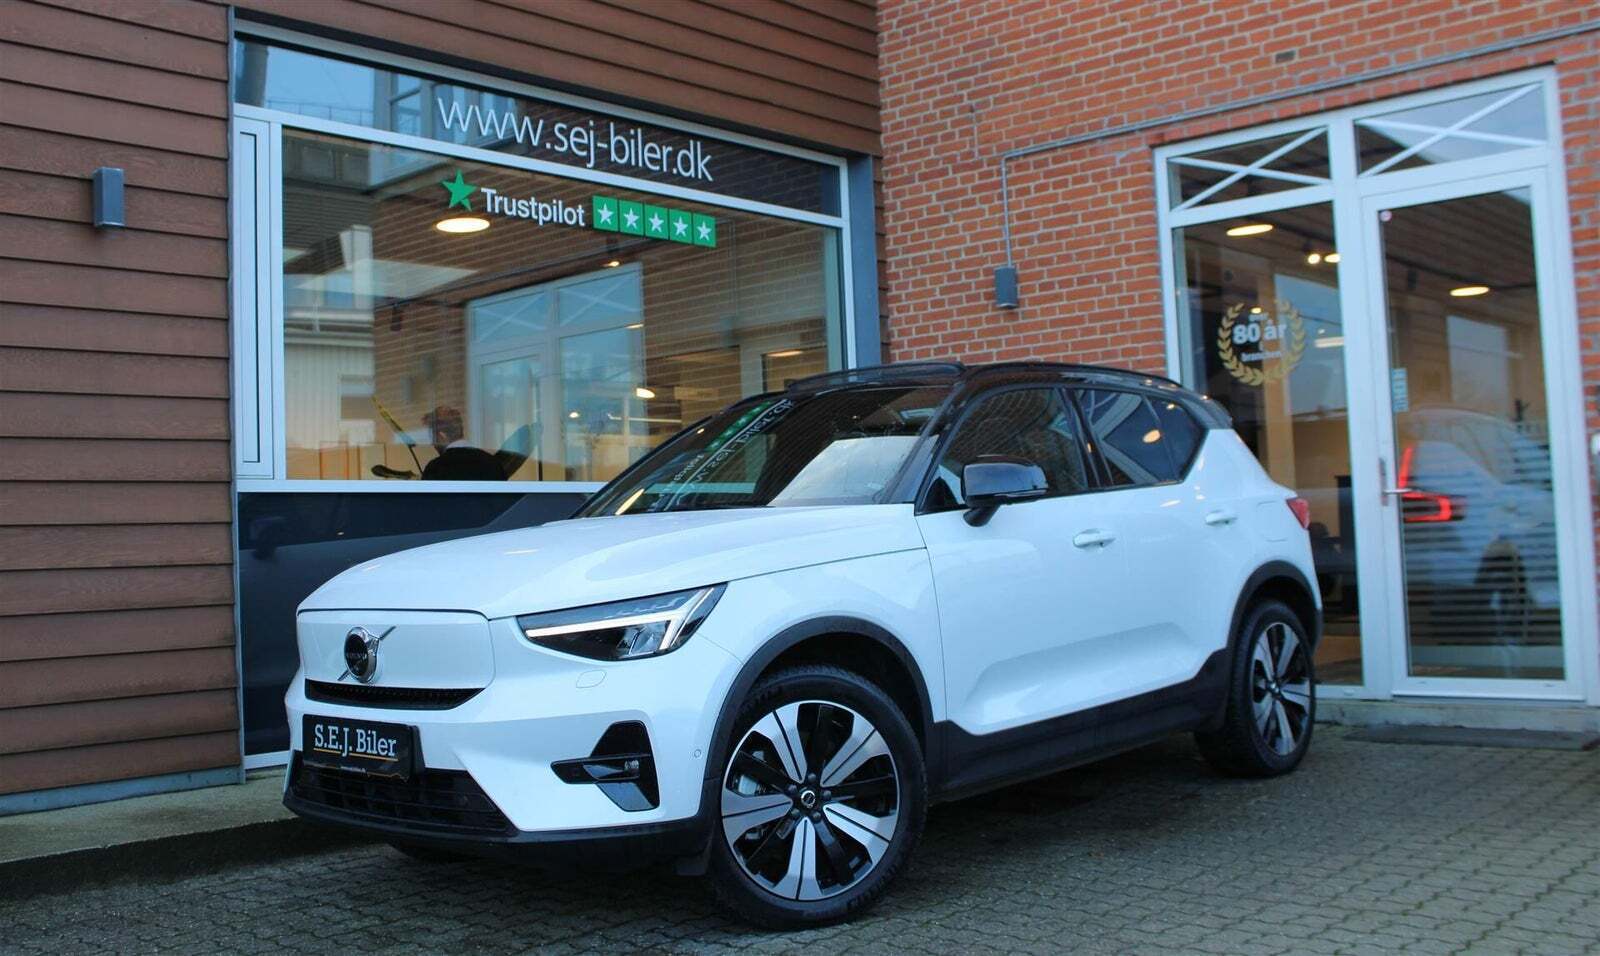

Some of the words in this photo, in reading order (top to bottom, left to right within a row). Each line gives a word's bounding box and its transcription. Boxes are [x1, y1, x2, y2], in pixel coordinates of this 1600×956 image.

[437, 97, 713, 182] www.sej-biler.dk
[481, 187, 586, 227] Trustpilot
[1233, 323, 1261, 344] 80
[1264, 319, 1288, 340] år
[314, 724, 353, 757] S.E.J.
[356, 729, 398, 757] Biler
